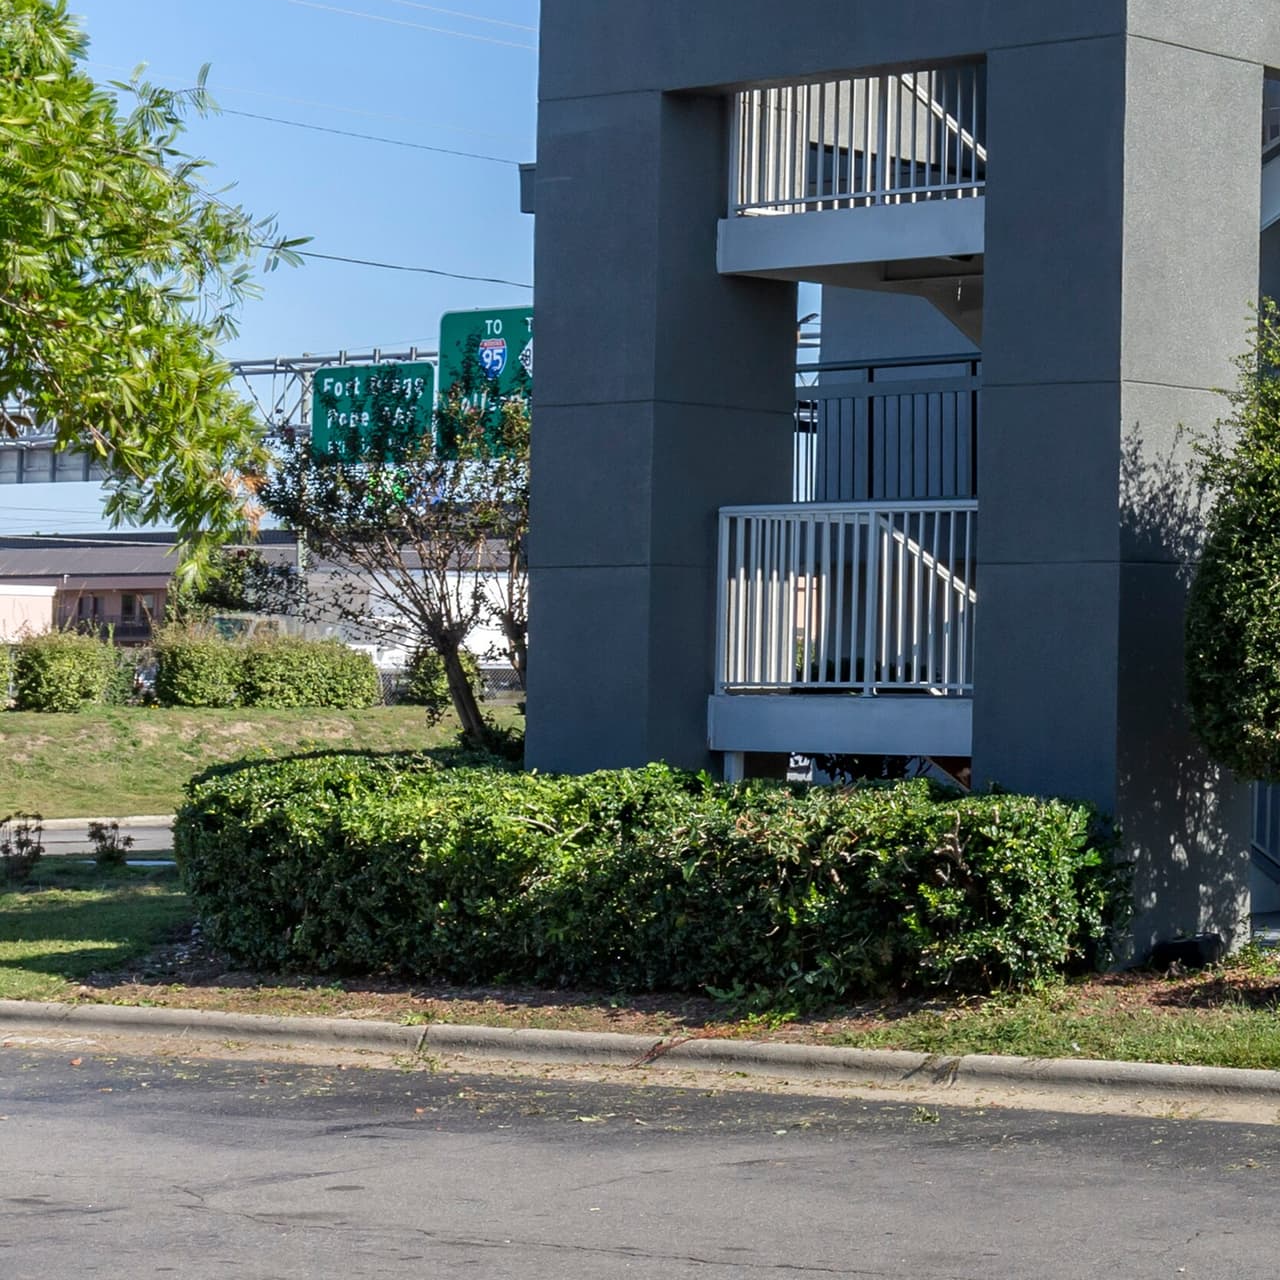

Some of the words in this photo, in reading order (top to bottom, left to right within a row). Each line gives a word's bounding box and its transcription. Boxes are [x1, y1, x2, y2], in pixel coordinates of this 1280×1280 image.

[485, 319, 503, 335] TO
[482, 349, 503, 373] 95
[323, 377, 361, 397] Fort
